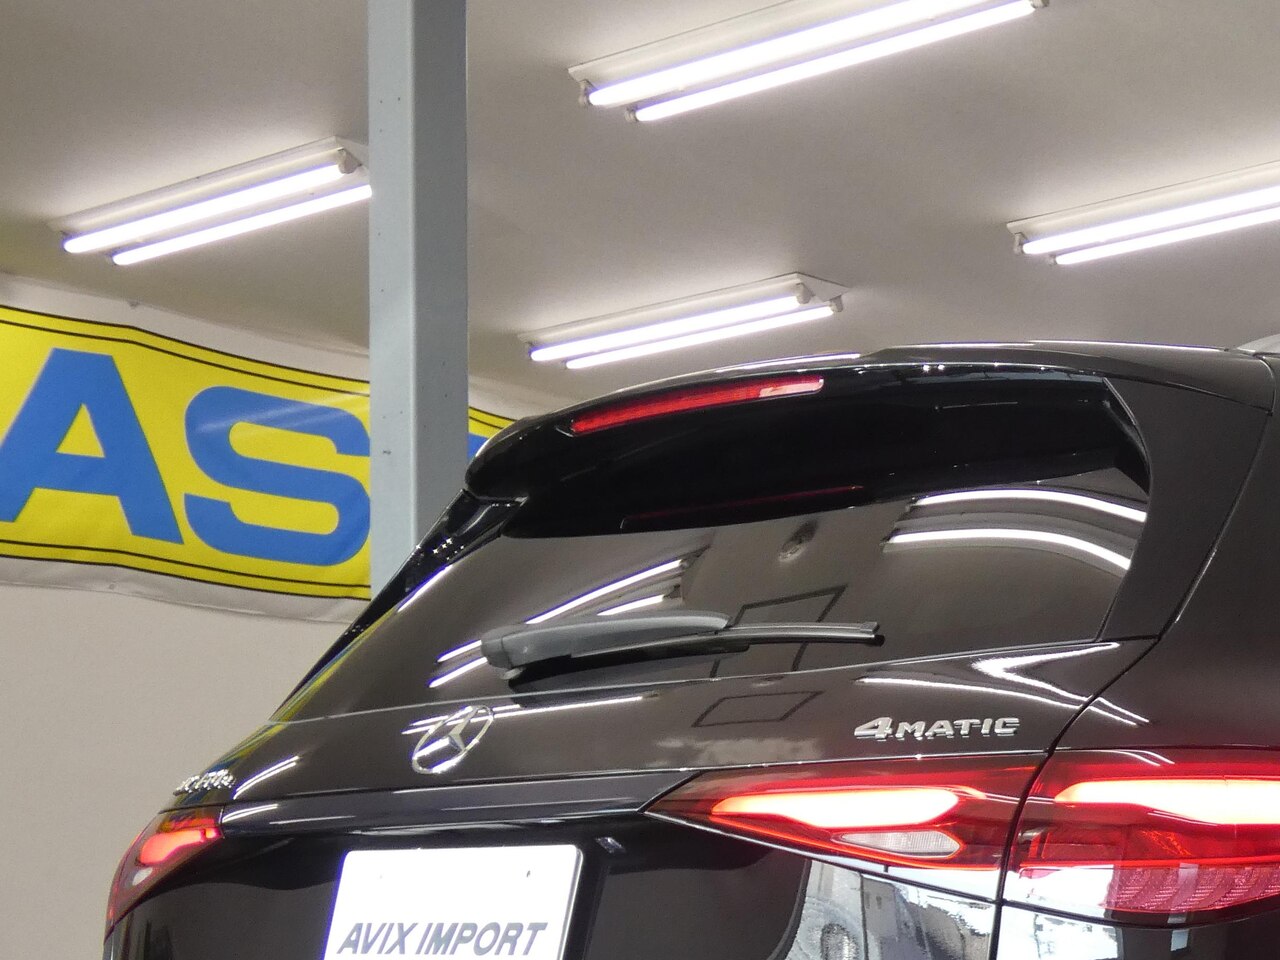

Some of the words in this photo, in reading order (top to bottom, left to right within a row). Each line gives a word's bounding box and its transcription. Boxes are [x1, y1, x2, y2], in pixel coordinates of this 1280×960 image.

[0, 347, 488, 566] AS
[854, 716, 1020, 742] 4MATIC
[336, 922, 418, 955] AVIX
[415, 921, 549, 957] IMPORT
